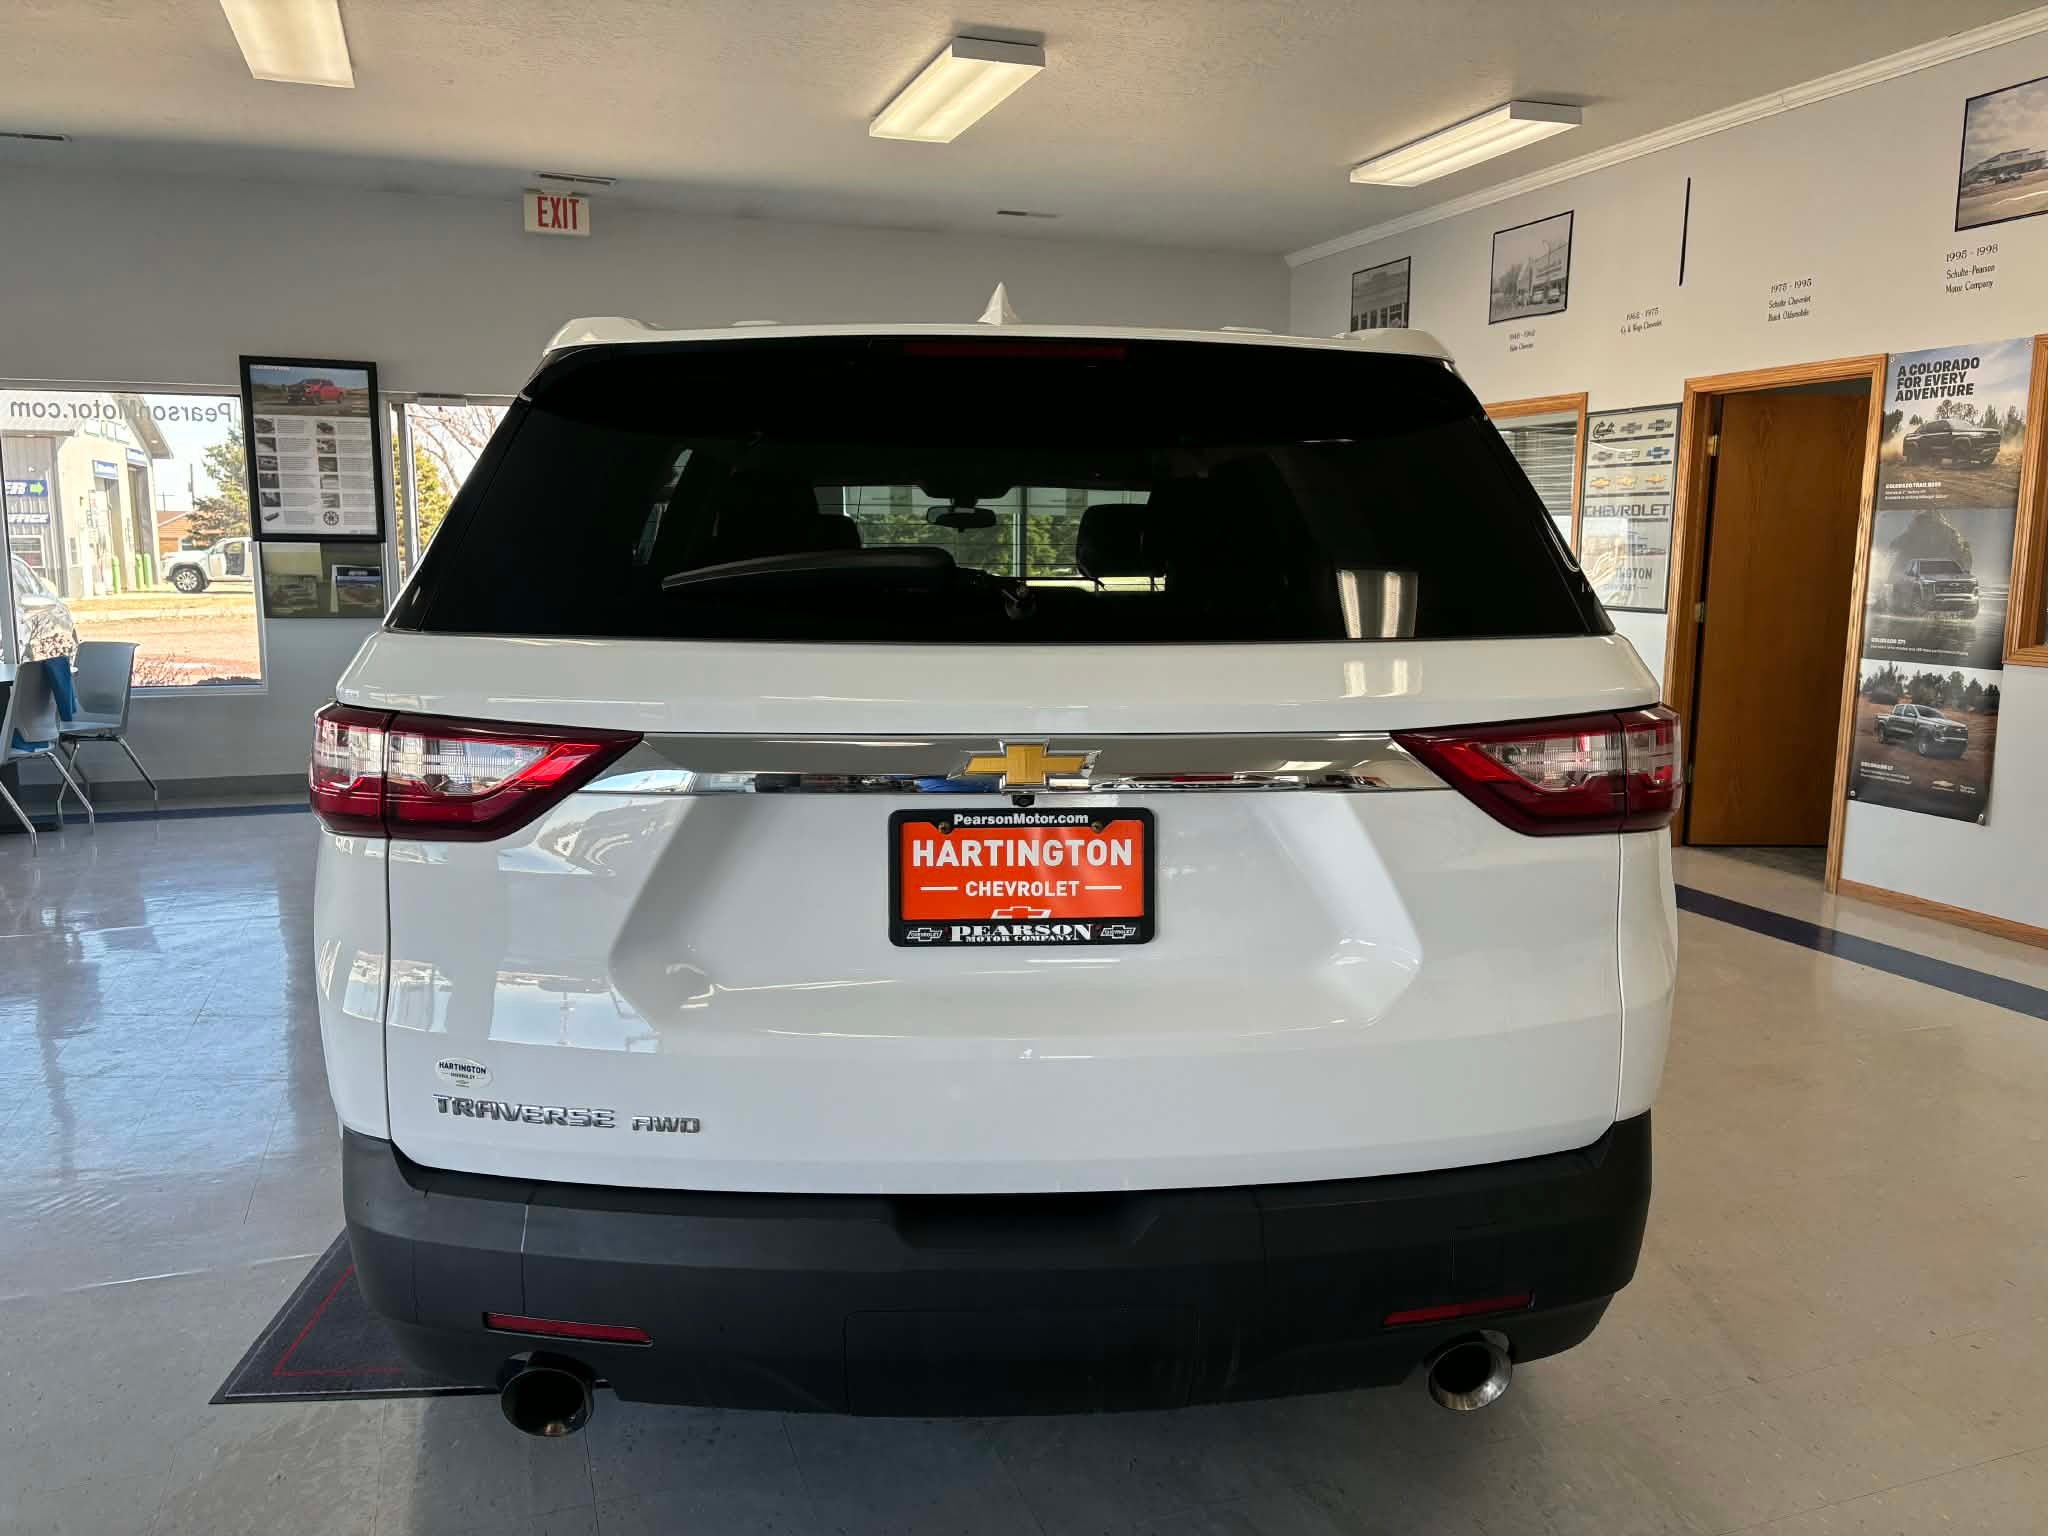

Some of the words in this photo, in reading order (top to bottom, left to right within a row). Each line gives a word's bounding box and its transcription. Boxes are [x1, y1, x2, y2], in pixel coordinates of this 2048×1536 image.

[537, 196, 579, 230] EXIT
[1945, 249, 1968, 262] 1995
[1976, 243, 1999, 256] 1998
[1897, 365, 1907, 378] A
[1908, 357, 1981, 377] COLORADO
[1896, 374, 1921, 390] FOR
[1924, 371, 1968, 387] EVERY
[1895, 383, 1975, 402] ADVENTURE
[1584, 503, 1671, 518] CHEVROLET
[953, 812, 1090, 826] PearsonMotor.com
[912, 838, 1133, 867] HARTINGTON
[965, 880, 1080, 897] CHEVROLET
[949, 923, 1093, 942] PEARSON
[965, 935, 1011, 943] MOTOR
[1014, 934, 1073, 942] COMPANY
[439, 1061, 487, 1075] HARTINGTON
[432, 1093, 616, 1129] TRAVERSE
[631, 1115, 702, 1134] AWD
